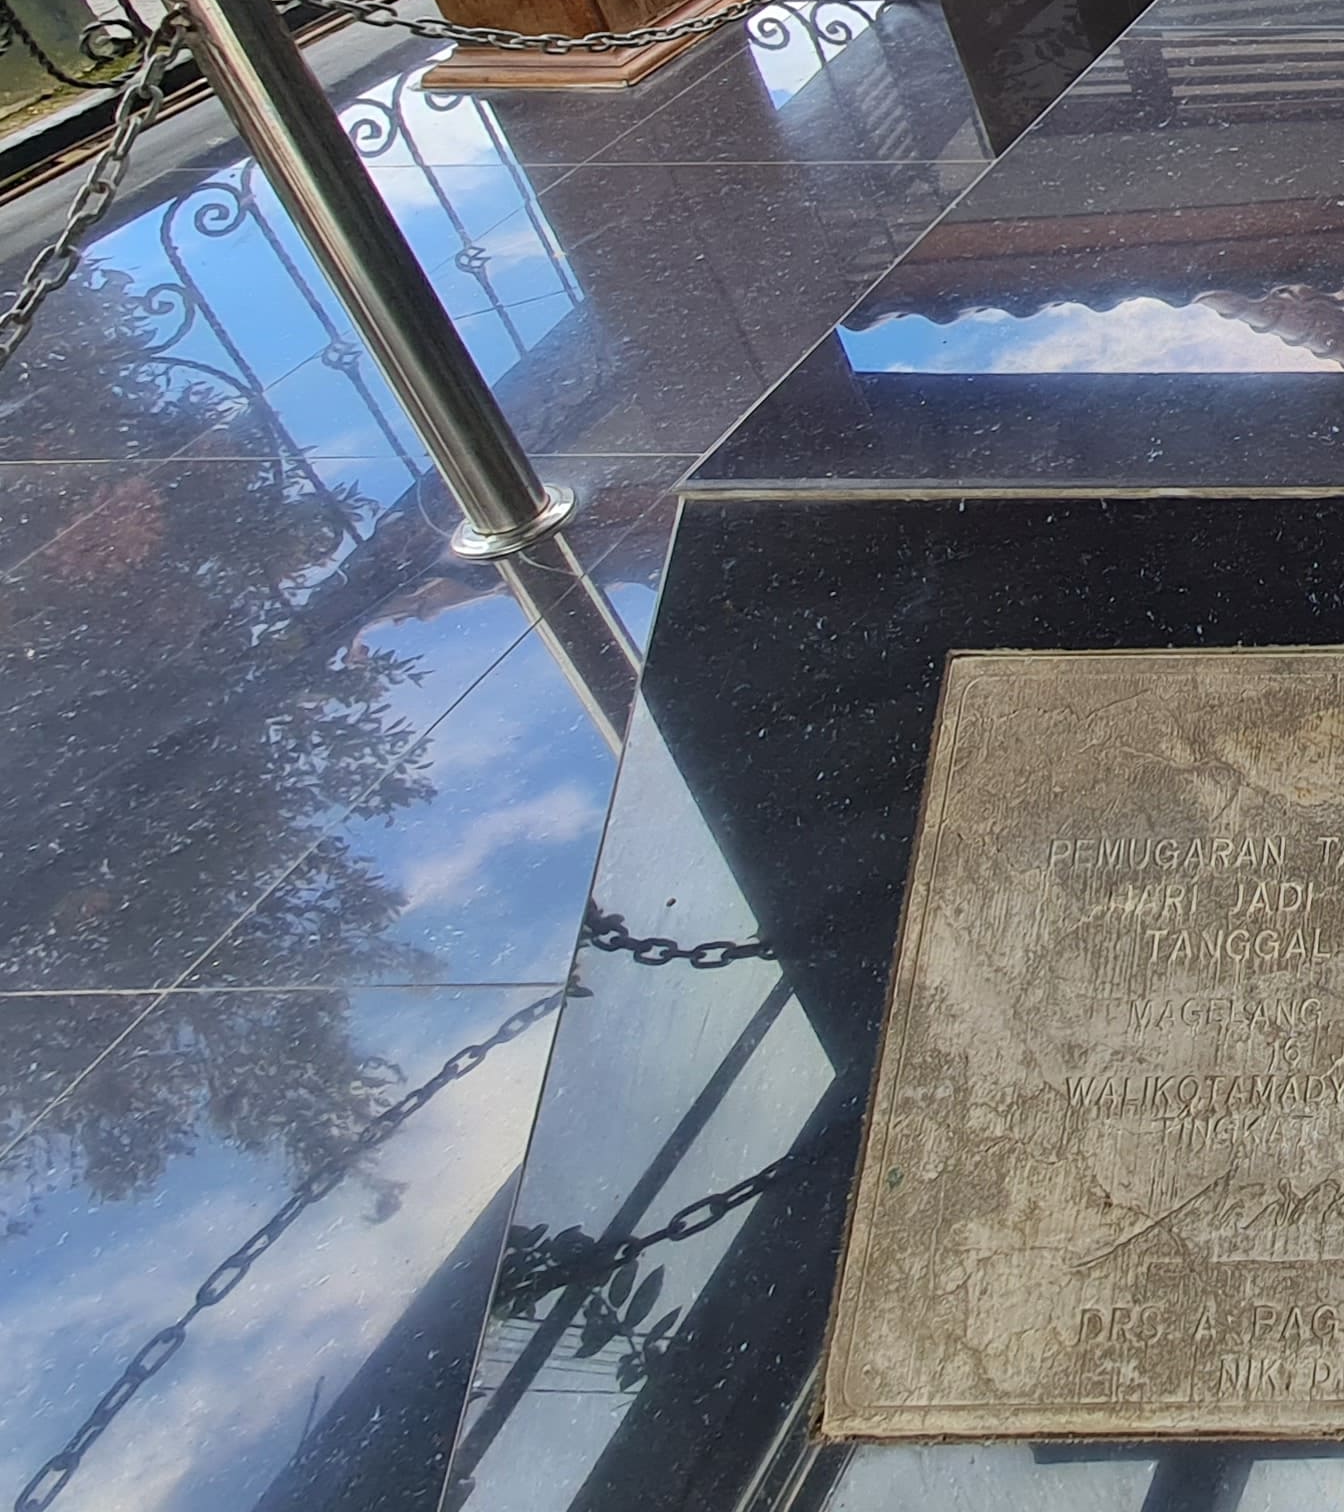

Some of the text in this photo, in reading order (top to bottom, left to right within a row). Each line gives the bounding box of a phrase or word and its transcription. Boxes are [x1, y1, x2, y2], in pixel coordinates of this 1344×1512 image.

[1049, 836, 1287, 869] PEMUGARAN
[1229, 881, 1315, 915] JADI
[1145, 928, 1332, 963] TANGGAL
